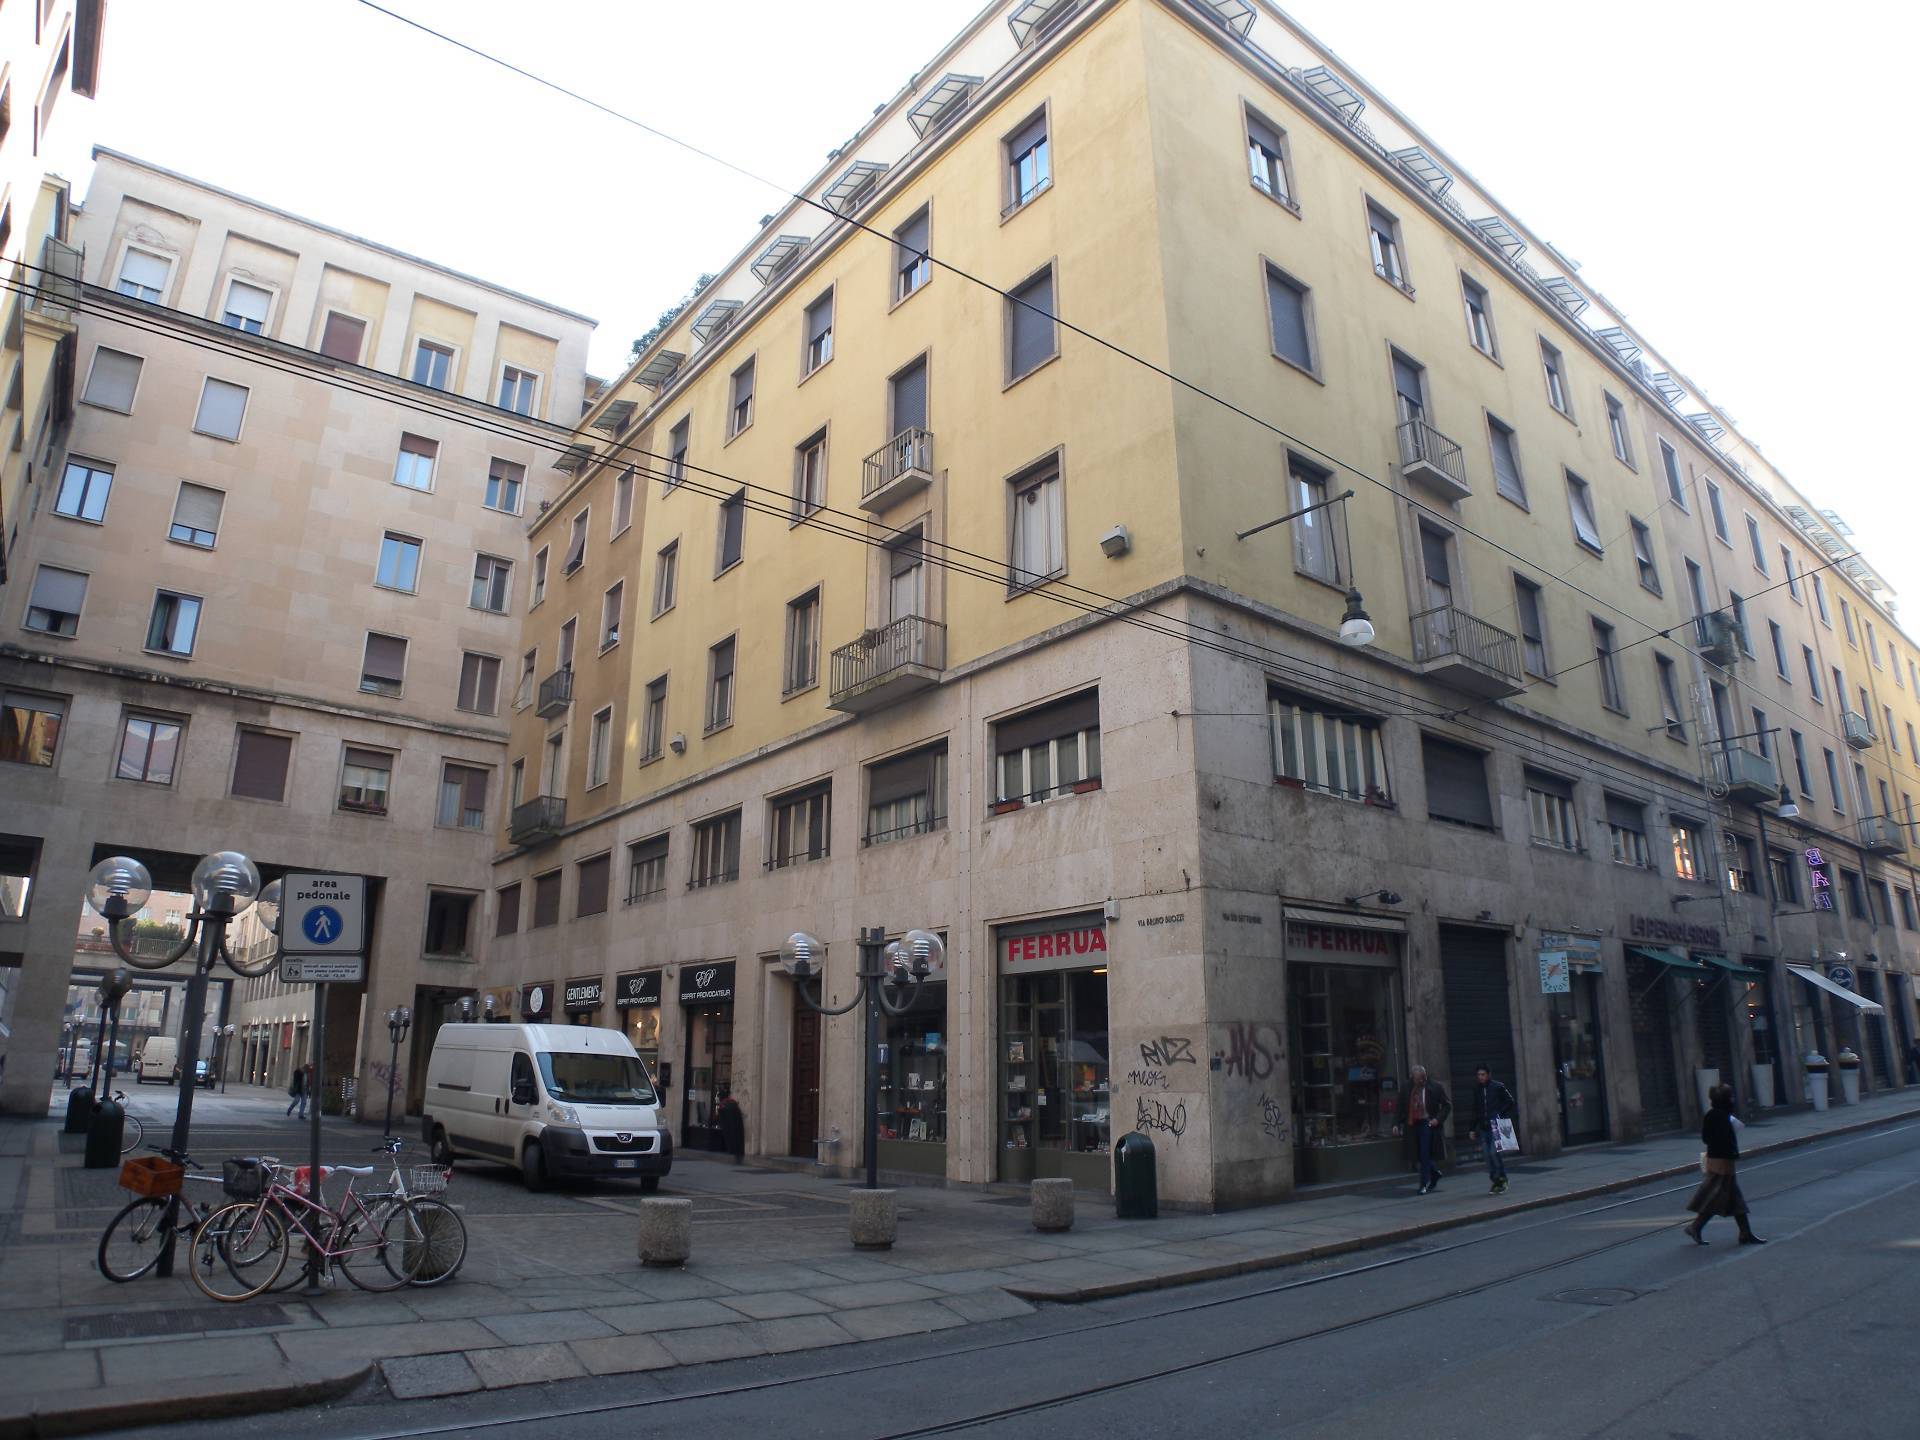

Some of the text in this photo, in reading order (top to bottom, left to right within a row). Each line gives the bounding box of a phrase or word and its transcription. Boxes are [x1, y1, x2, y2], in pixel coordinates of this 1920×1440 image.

[312, 880, 337, 888] area
[297, 891, 351, 900] pedonale
[1138, 918, 1146, 927] VIA
[1146, 915, 1164, 926] BRUNO
[1008, 927, 1107, 962] FERRUA
[1307, 926, 1389, 955] FERRUA
[566, 984, 600, 1001] GENTLEMEN'S
[681, 989, 731, 1000] ESPRIT PROVOCATEUR
[630, 996, 658, 1004] PROVOCATEUR
